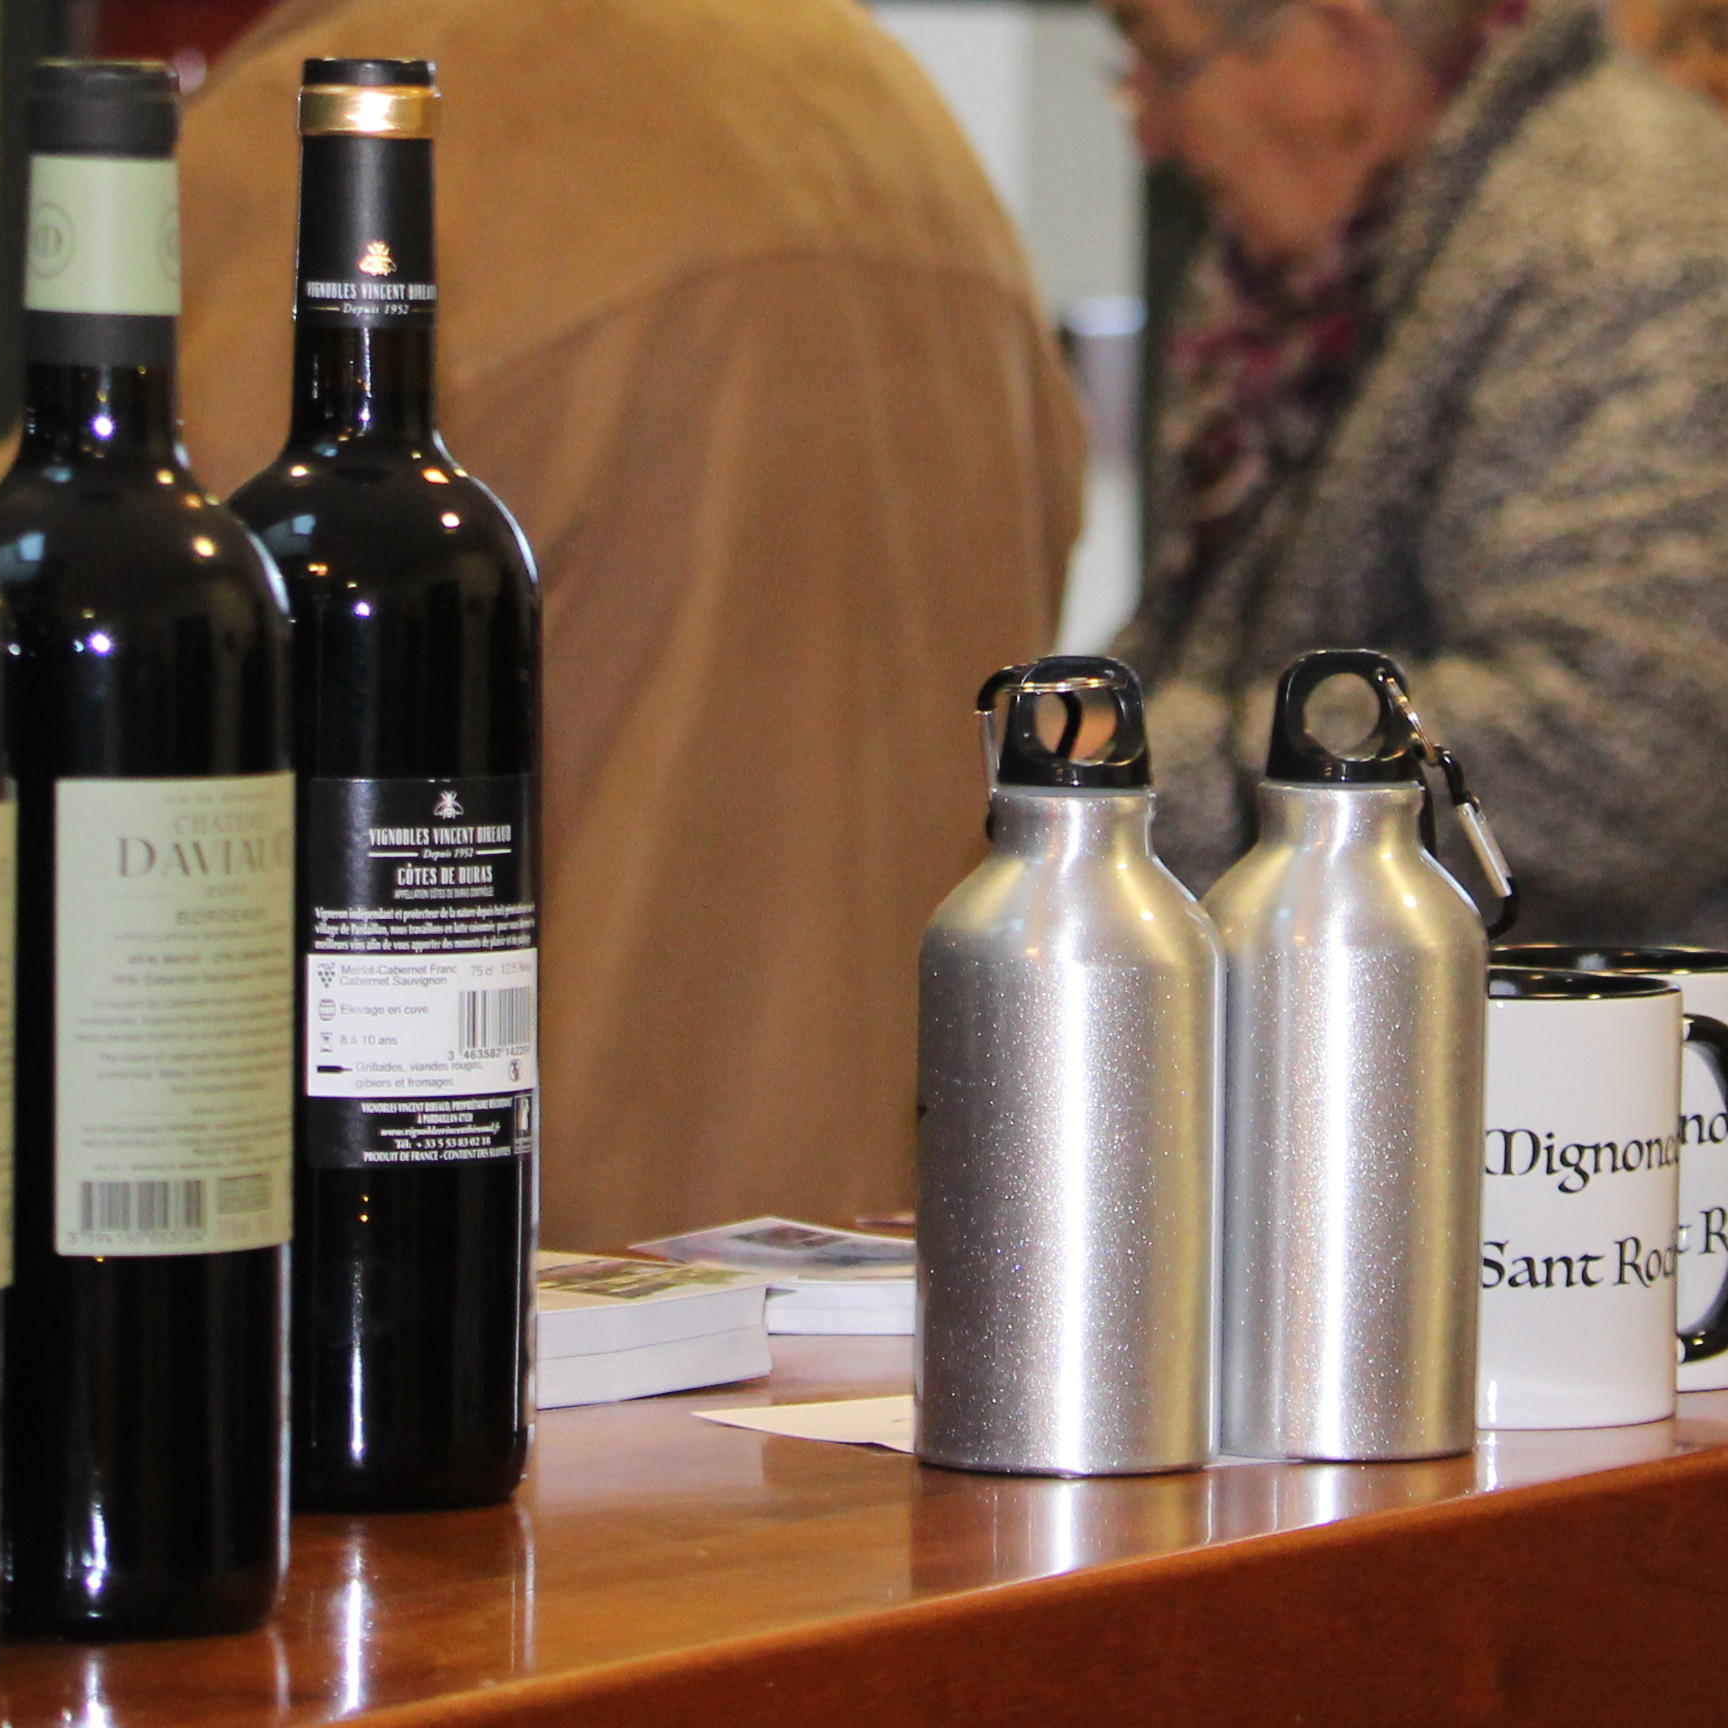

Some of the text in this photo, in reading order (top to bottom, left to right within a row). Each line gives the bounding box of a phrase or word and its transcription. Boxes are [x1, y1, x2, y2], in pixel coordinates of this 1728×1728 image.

[307, 281, 357, 299] VIGNOBLES
[361, 282, 406, 300] VINCENT
[384, 304, 410, 315] 1952
[369, 828, 430, 847] VIGNOBLES
[433, 827, 475, 845] VINCENT
[423, 848, 474, 861] Depuis 1952
[397, 863, 493, 886] CÔTES DE DURAS
[430, 964, 458, 974] Franc
[471, 965, 484, 977] 75
[339, 975, 447, 988] Cabernet Sauvignon
[387, 1006, 401, 1015] en
[404, 1005, 429, 1015] cuve
[340, 1035, 348, 1045] 8
[363, 1035, 376, 1045] 10
[378, 1036, 398, 1045] ans
[447, 1050, 455, 1061] 3
[464, 1048, 502, 1060] 463582
[356, 1062, 407, 1073] Grillades,
[409, 1061, 449, 1072] viandes
[356, 1077, 454, 1090] gibiers et fromages
[424, 1138, 437, 1149] 33
[438, 1138, 444, 1149] 5
[445, 1137, 457, 1149] 53
[363, 1151, 398, 1162] PRODUIT
[399, 1151, 410, 1162] DE
[411, 1150, 439, 1161] FRANCE
[1482, 1239, 1606, 1290] Sant
